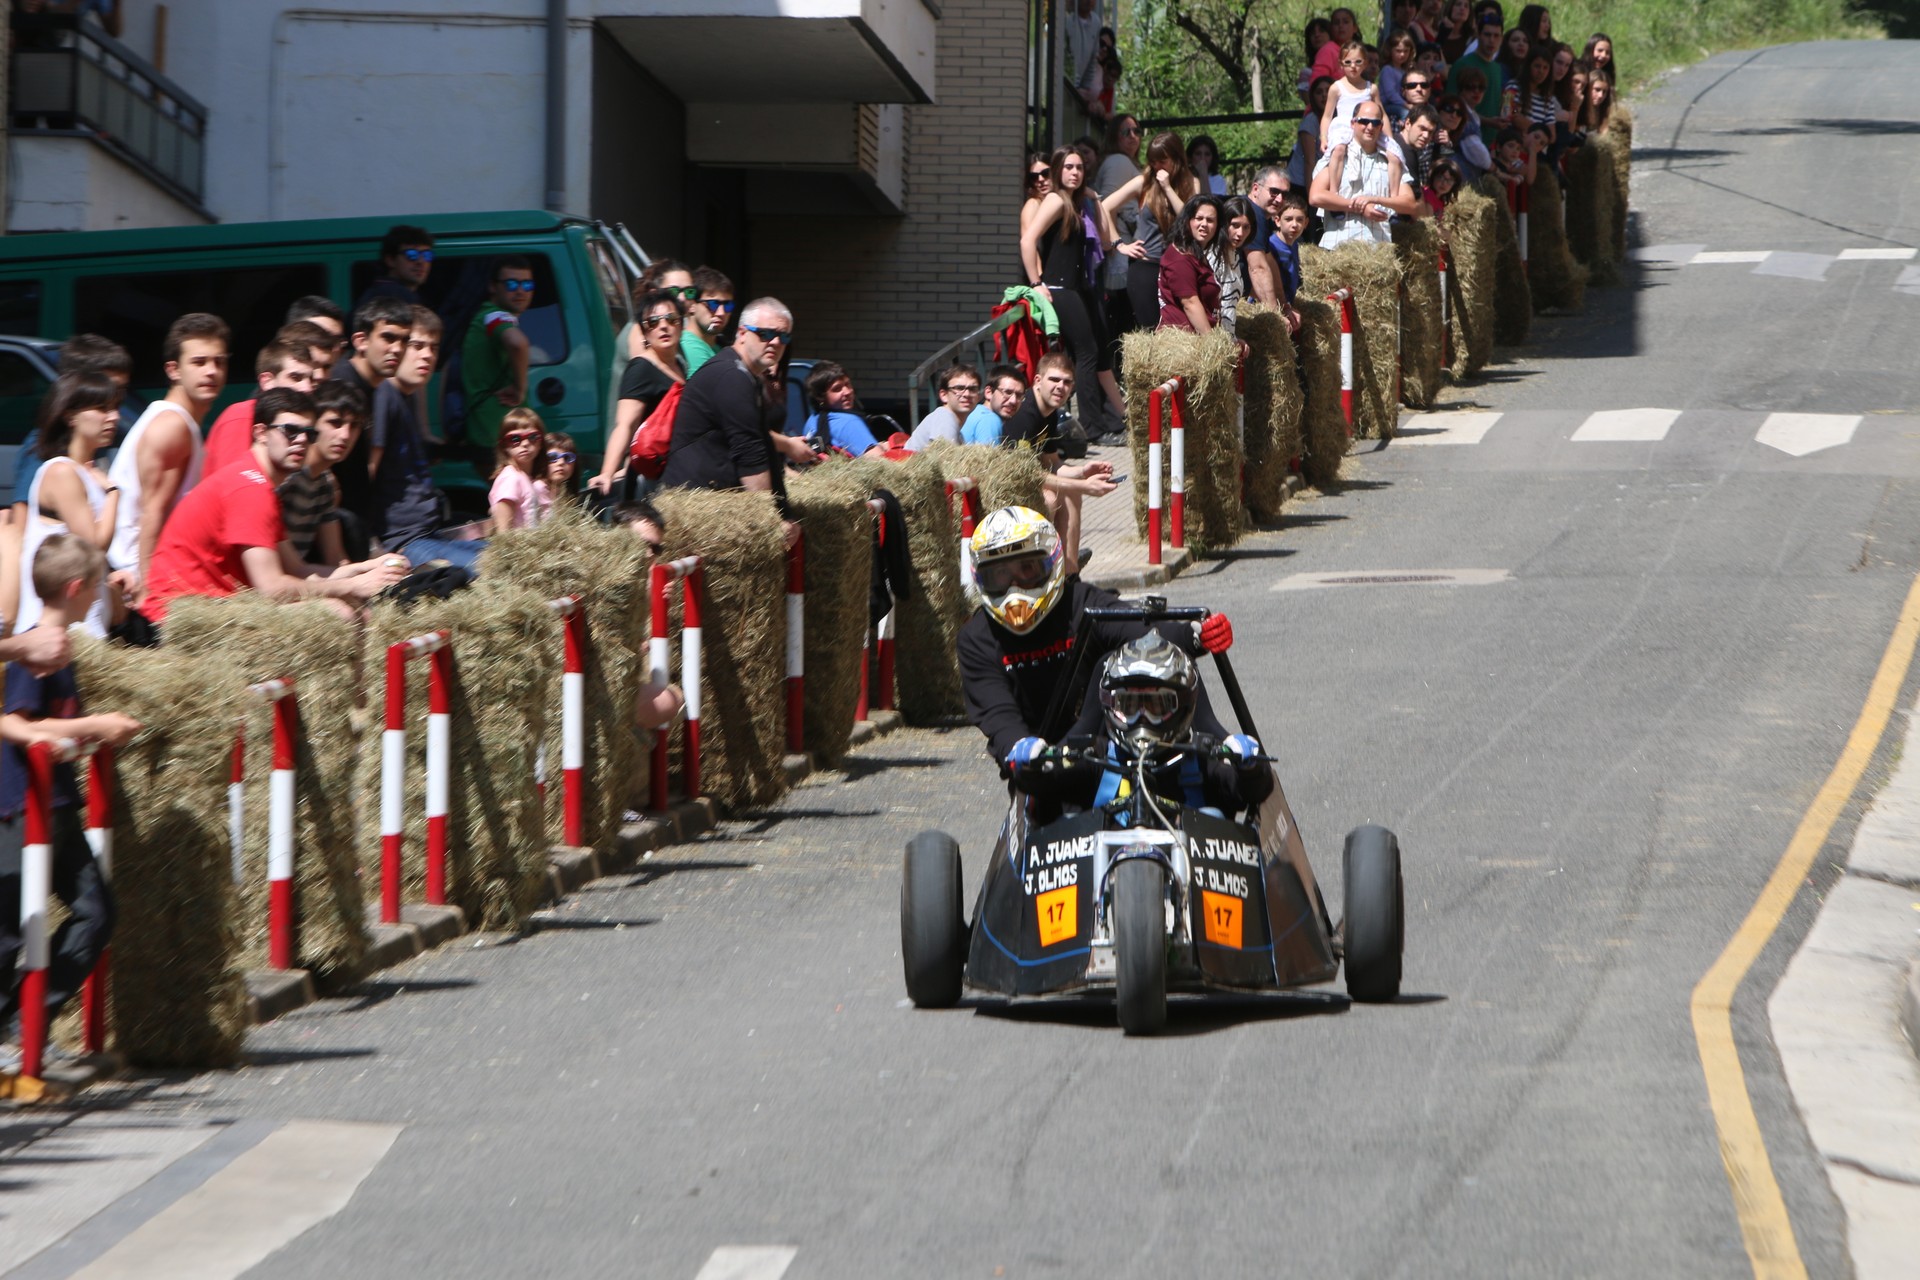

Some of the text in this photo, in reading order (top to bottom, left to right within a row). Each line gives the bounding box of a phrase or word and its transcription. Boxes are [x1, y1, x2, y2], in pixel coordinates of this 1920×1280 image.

[1005, 651, 1068, 671] RACIN
[1047, 902, 1064, 923] 17
[1214, 906, 1232, 928] 17
